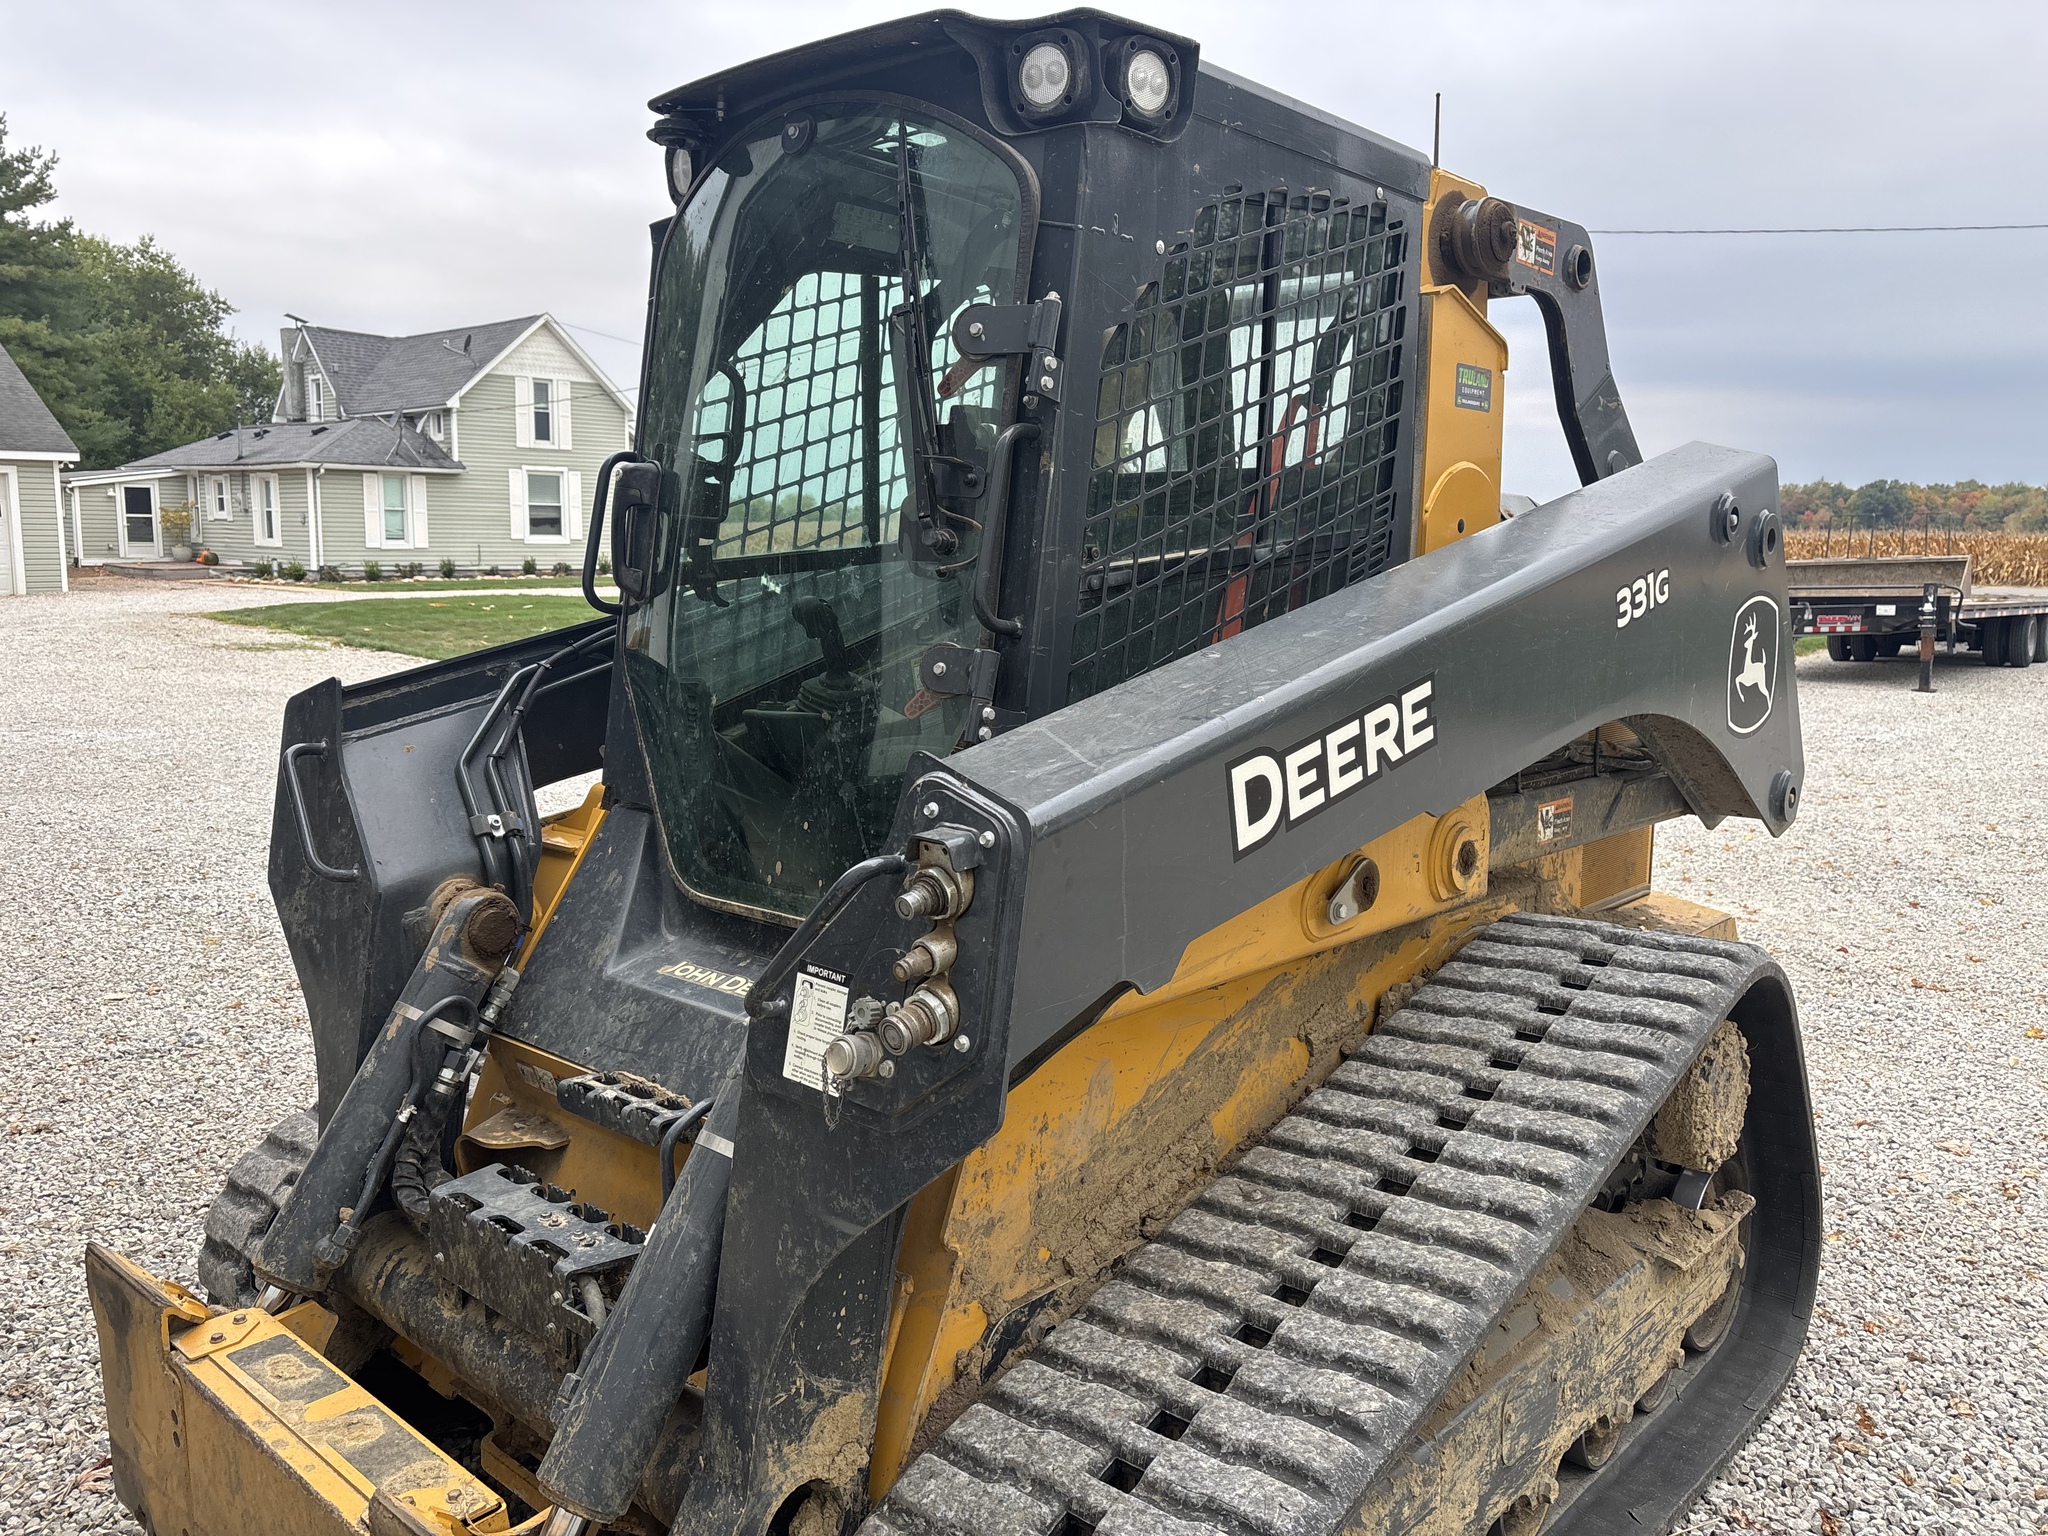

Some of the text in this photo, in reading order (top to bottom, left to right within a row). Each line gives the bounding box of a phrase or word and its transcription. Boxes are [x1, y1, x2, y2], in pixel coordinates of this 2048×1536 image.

[1459, 367, 1489, 388] TRULAND
[1462, 386, 1485, 397] EQUIPMENT
[1617, 570, 1668, 628] 331G
[1231, 681, 1434, 851] DEERE
[660, 961, 727, 986] JOHN
[806, 964, 846, 983] IMPORTANT
